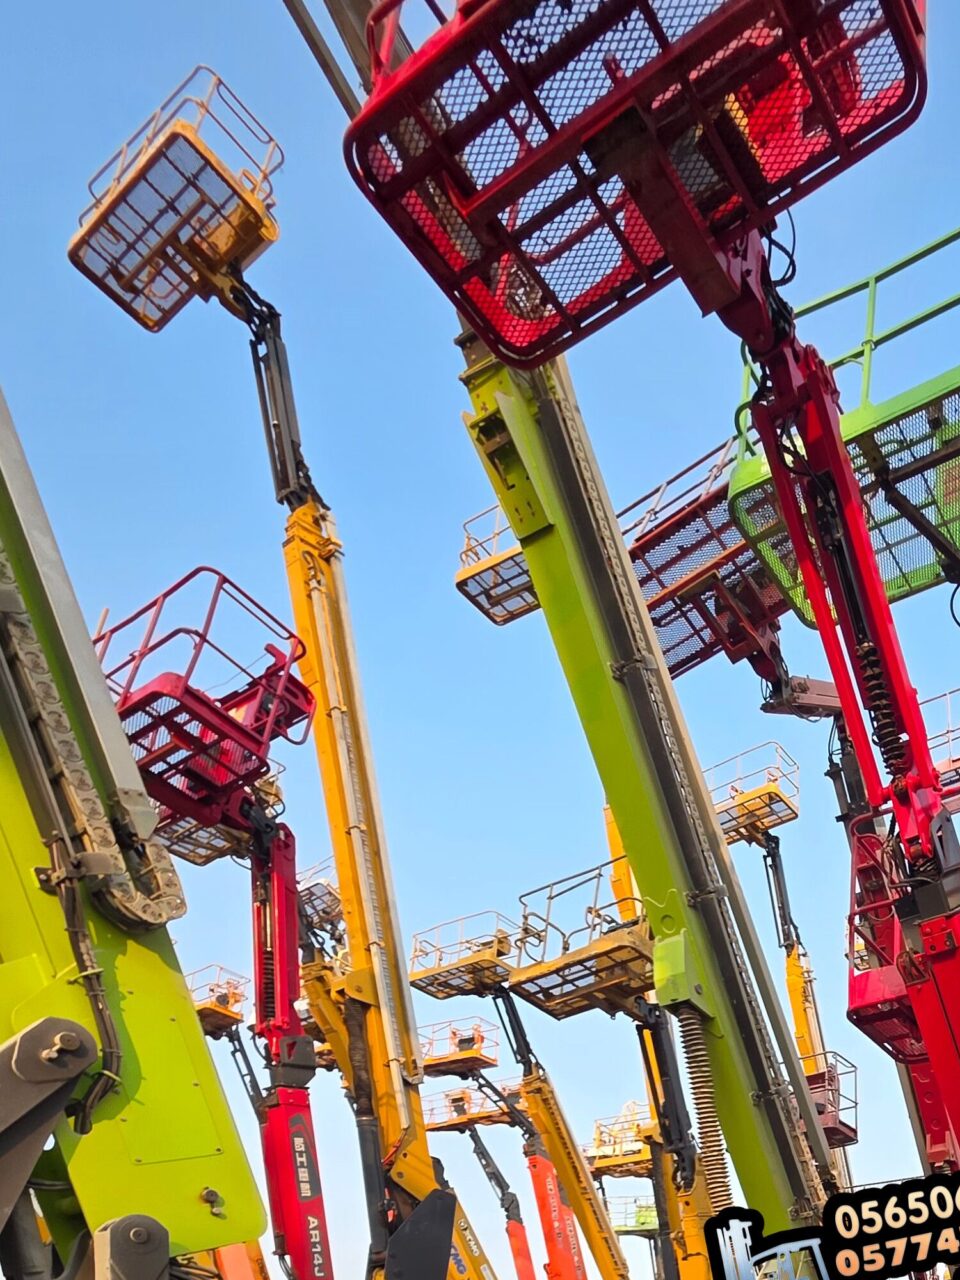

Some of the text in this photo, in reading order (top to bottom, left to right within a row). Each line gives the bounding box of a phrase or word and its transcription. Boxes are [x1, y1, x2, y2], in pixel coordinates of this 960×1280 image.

[307, 1216, 325, 1277] AR14J
[450, 1242, 467, 1275] CMG
[463, 1229, 480, 1257] XCMG
